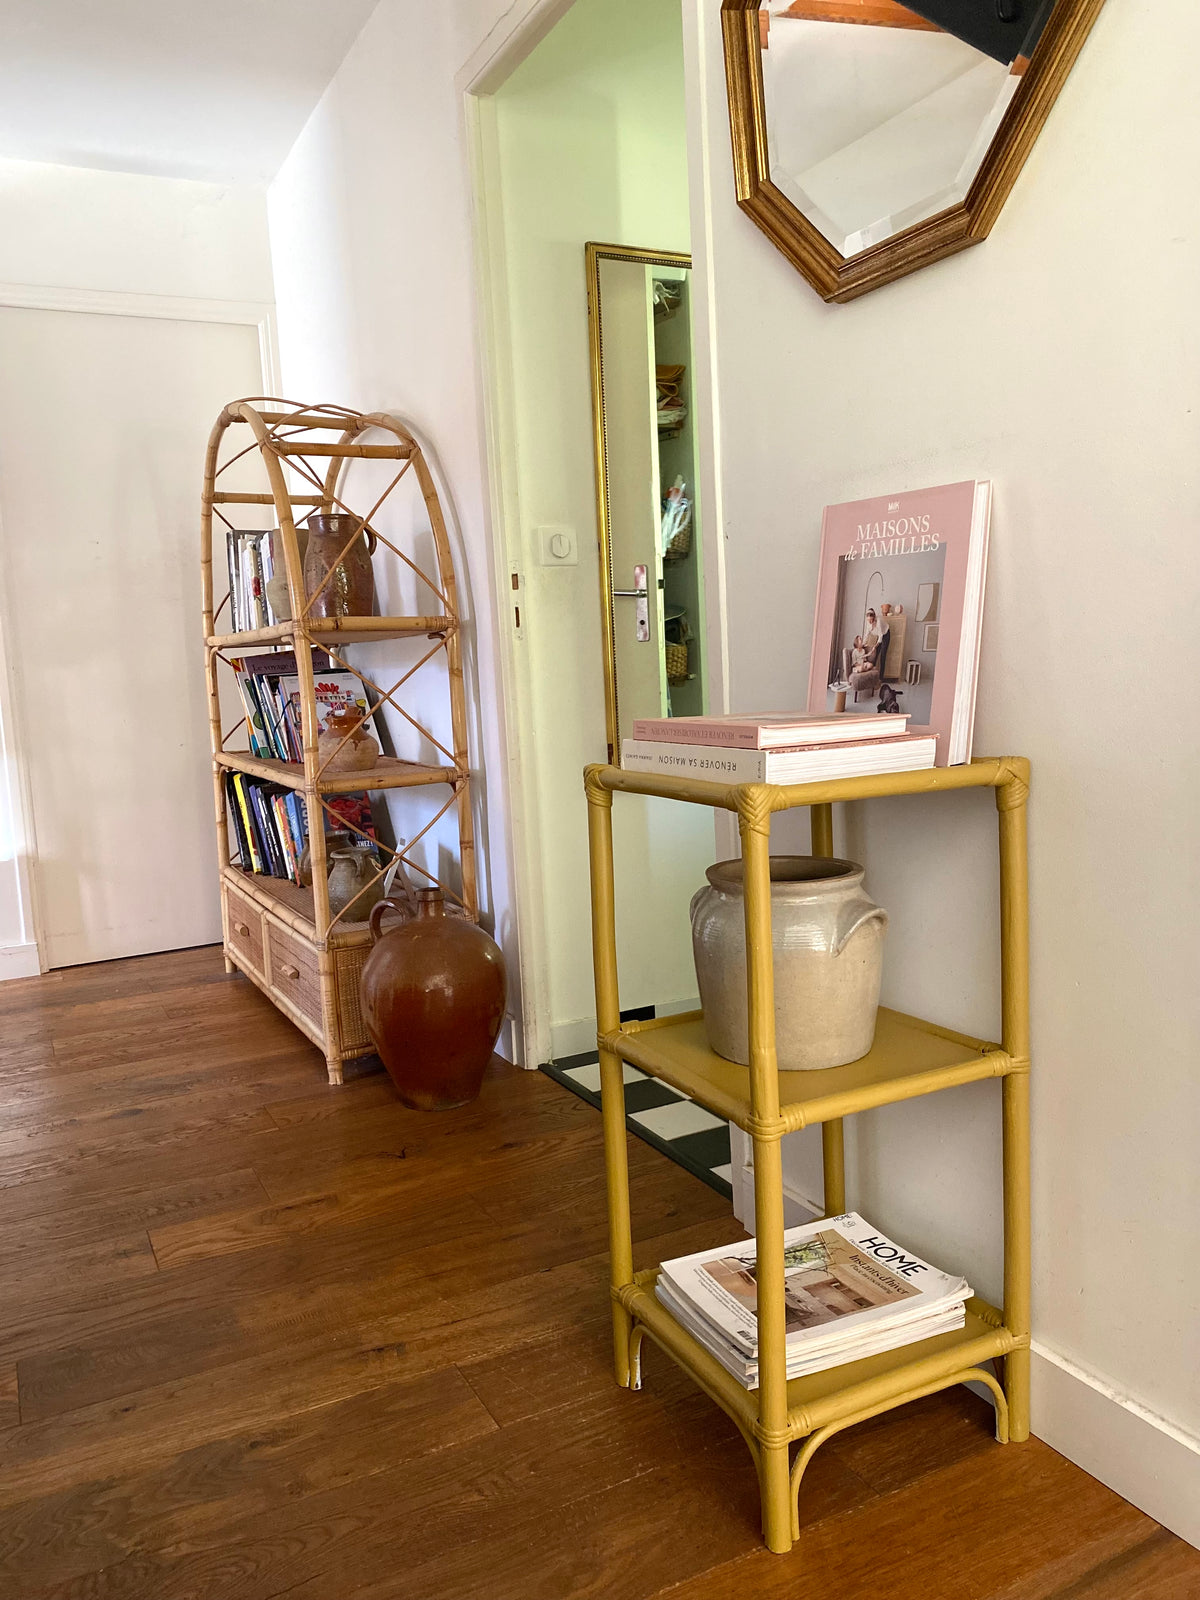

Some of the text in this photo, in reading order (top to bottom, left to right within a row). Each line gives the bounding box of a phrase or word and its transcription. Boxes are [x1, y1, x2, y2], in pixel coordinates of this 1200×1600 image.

[855, 514, 930, 542] MAISONS
[844, 533, 940, 561] de FAMILLES
[658, 755, 687, 766] MAISON
[688, 758, 698, 768] SA
[700, 759, 737, 772] RÉNOVER
[858, 1236, 929, 1277] HOME
[849, 1254, 880, 1278] Instants
[879, 1274, 910, 1295] d'hiver
